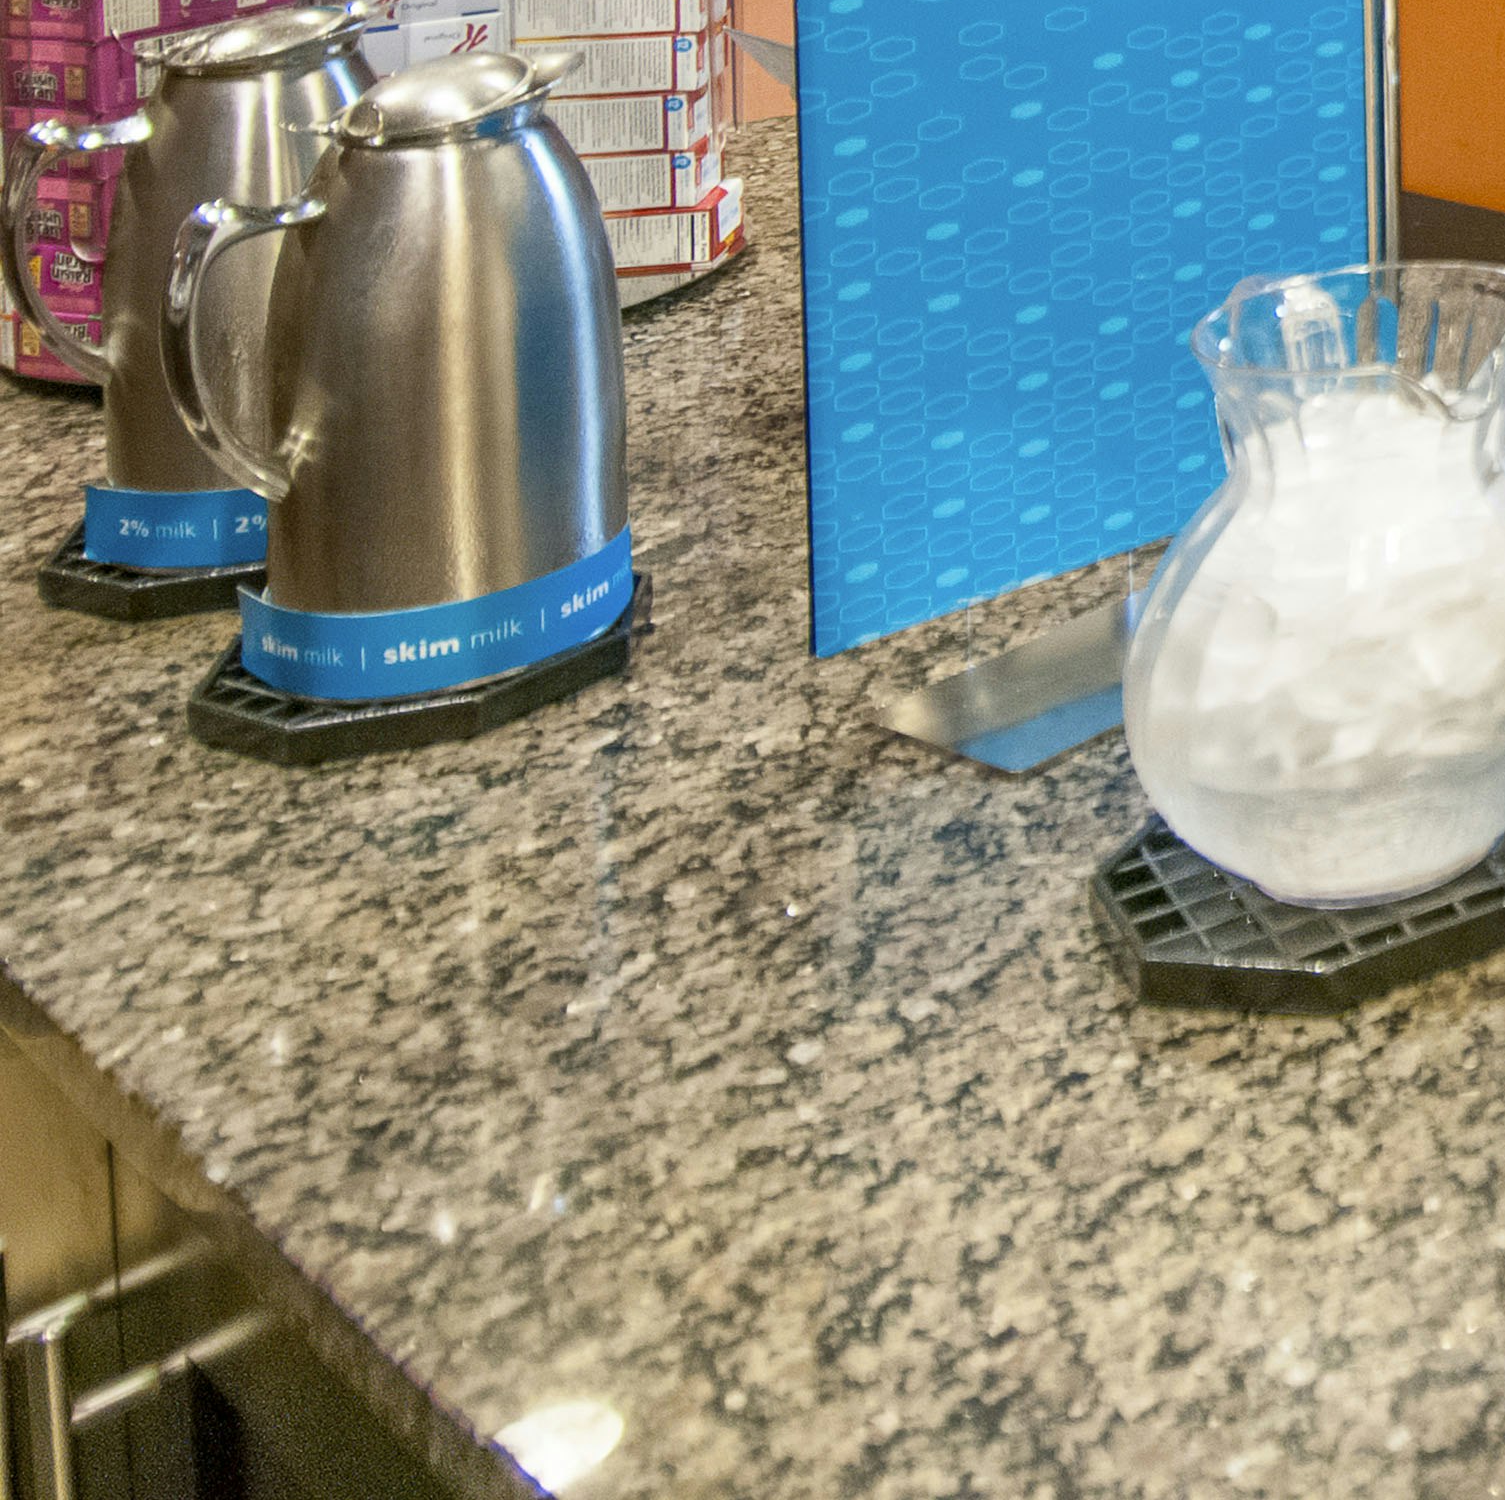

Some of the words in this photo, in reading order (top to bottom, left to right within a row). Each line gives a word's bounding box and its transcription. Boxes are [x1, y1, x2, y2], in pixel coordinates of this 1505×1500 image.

[119, 517, 149, 538] 2%
[155, 520, 197, 540] milk
[262, 633, 298, 662] skim
[304, 646, 343, 667] milk
[383, 636, 460, 665] skim
[470, 618, 522, 649] milk
[560, 579, 609, 619] skim
